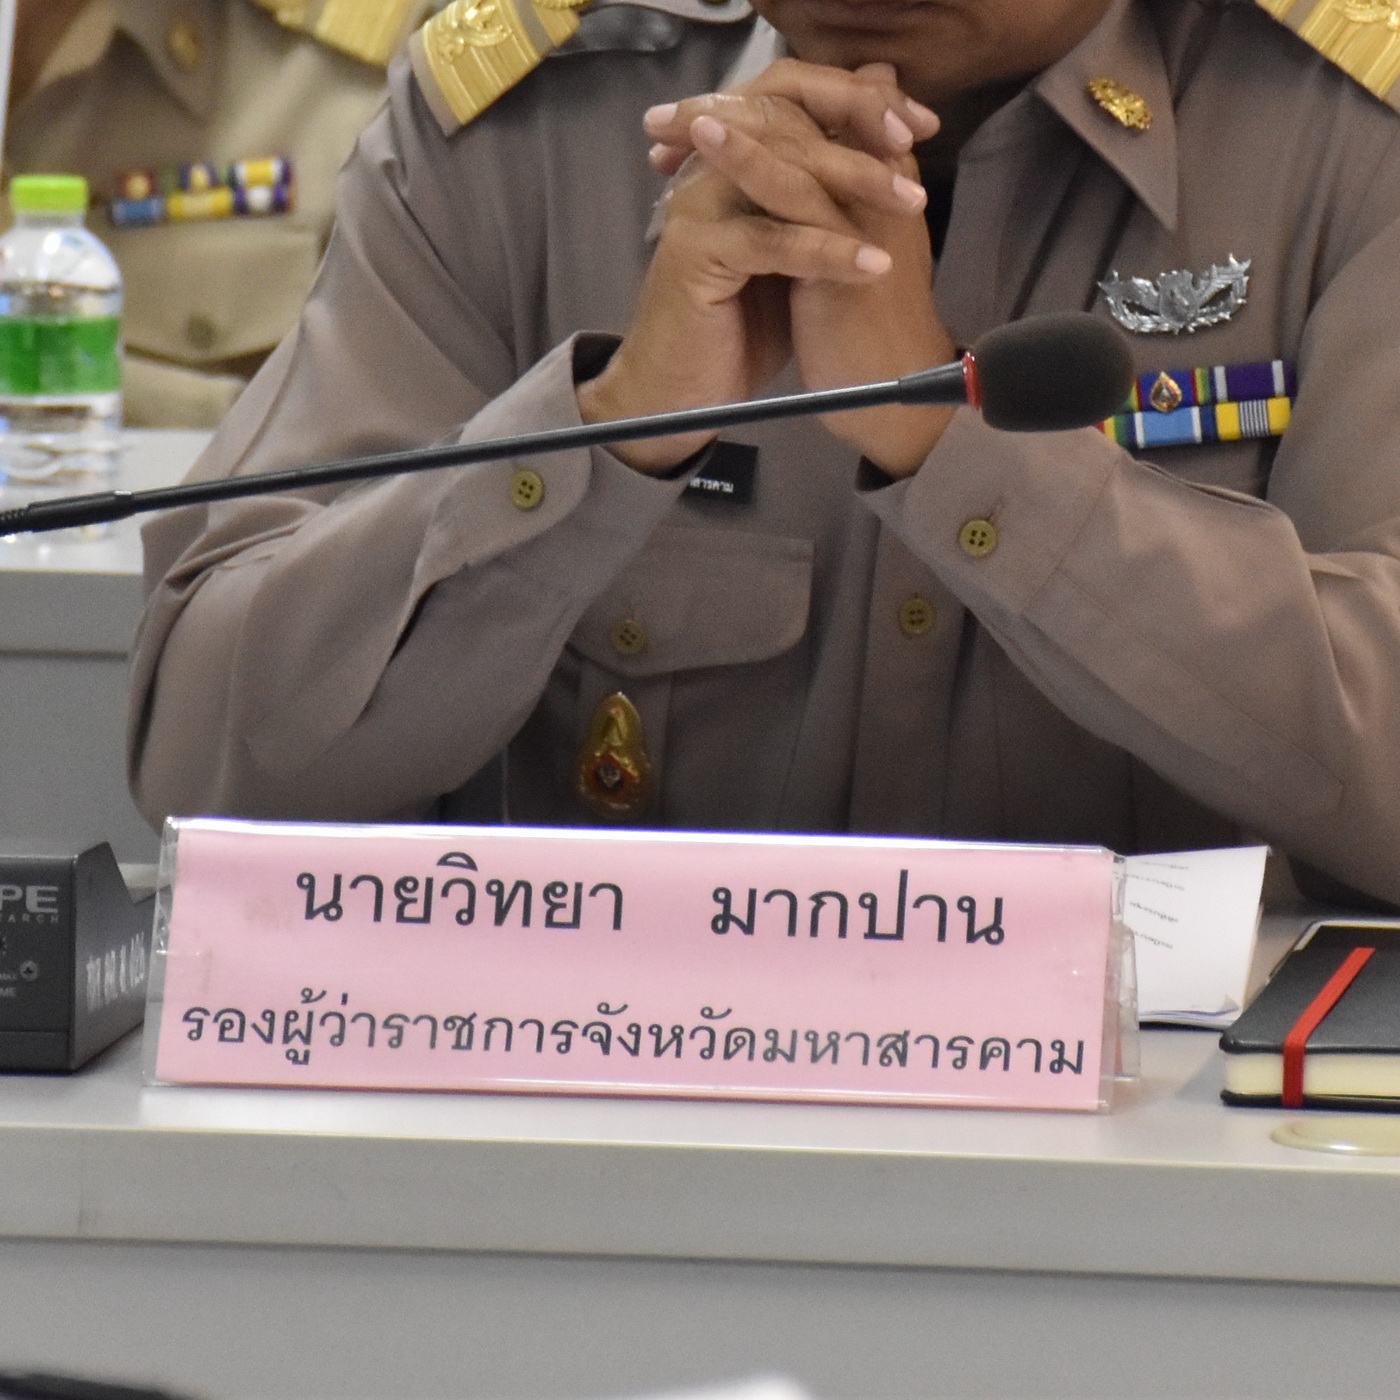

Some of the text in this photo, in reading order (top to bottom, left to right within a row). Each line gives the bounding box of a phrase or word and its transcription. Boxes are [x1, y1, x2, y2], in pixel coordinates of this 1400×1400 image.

[296, 852, 1006, 947] นายวิทยา มากปาน
[181, 986, 1087, 1077] รองผู้ว่าราชการจังหวัดมหาสารคาม
